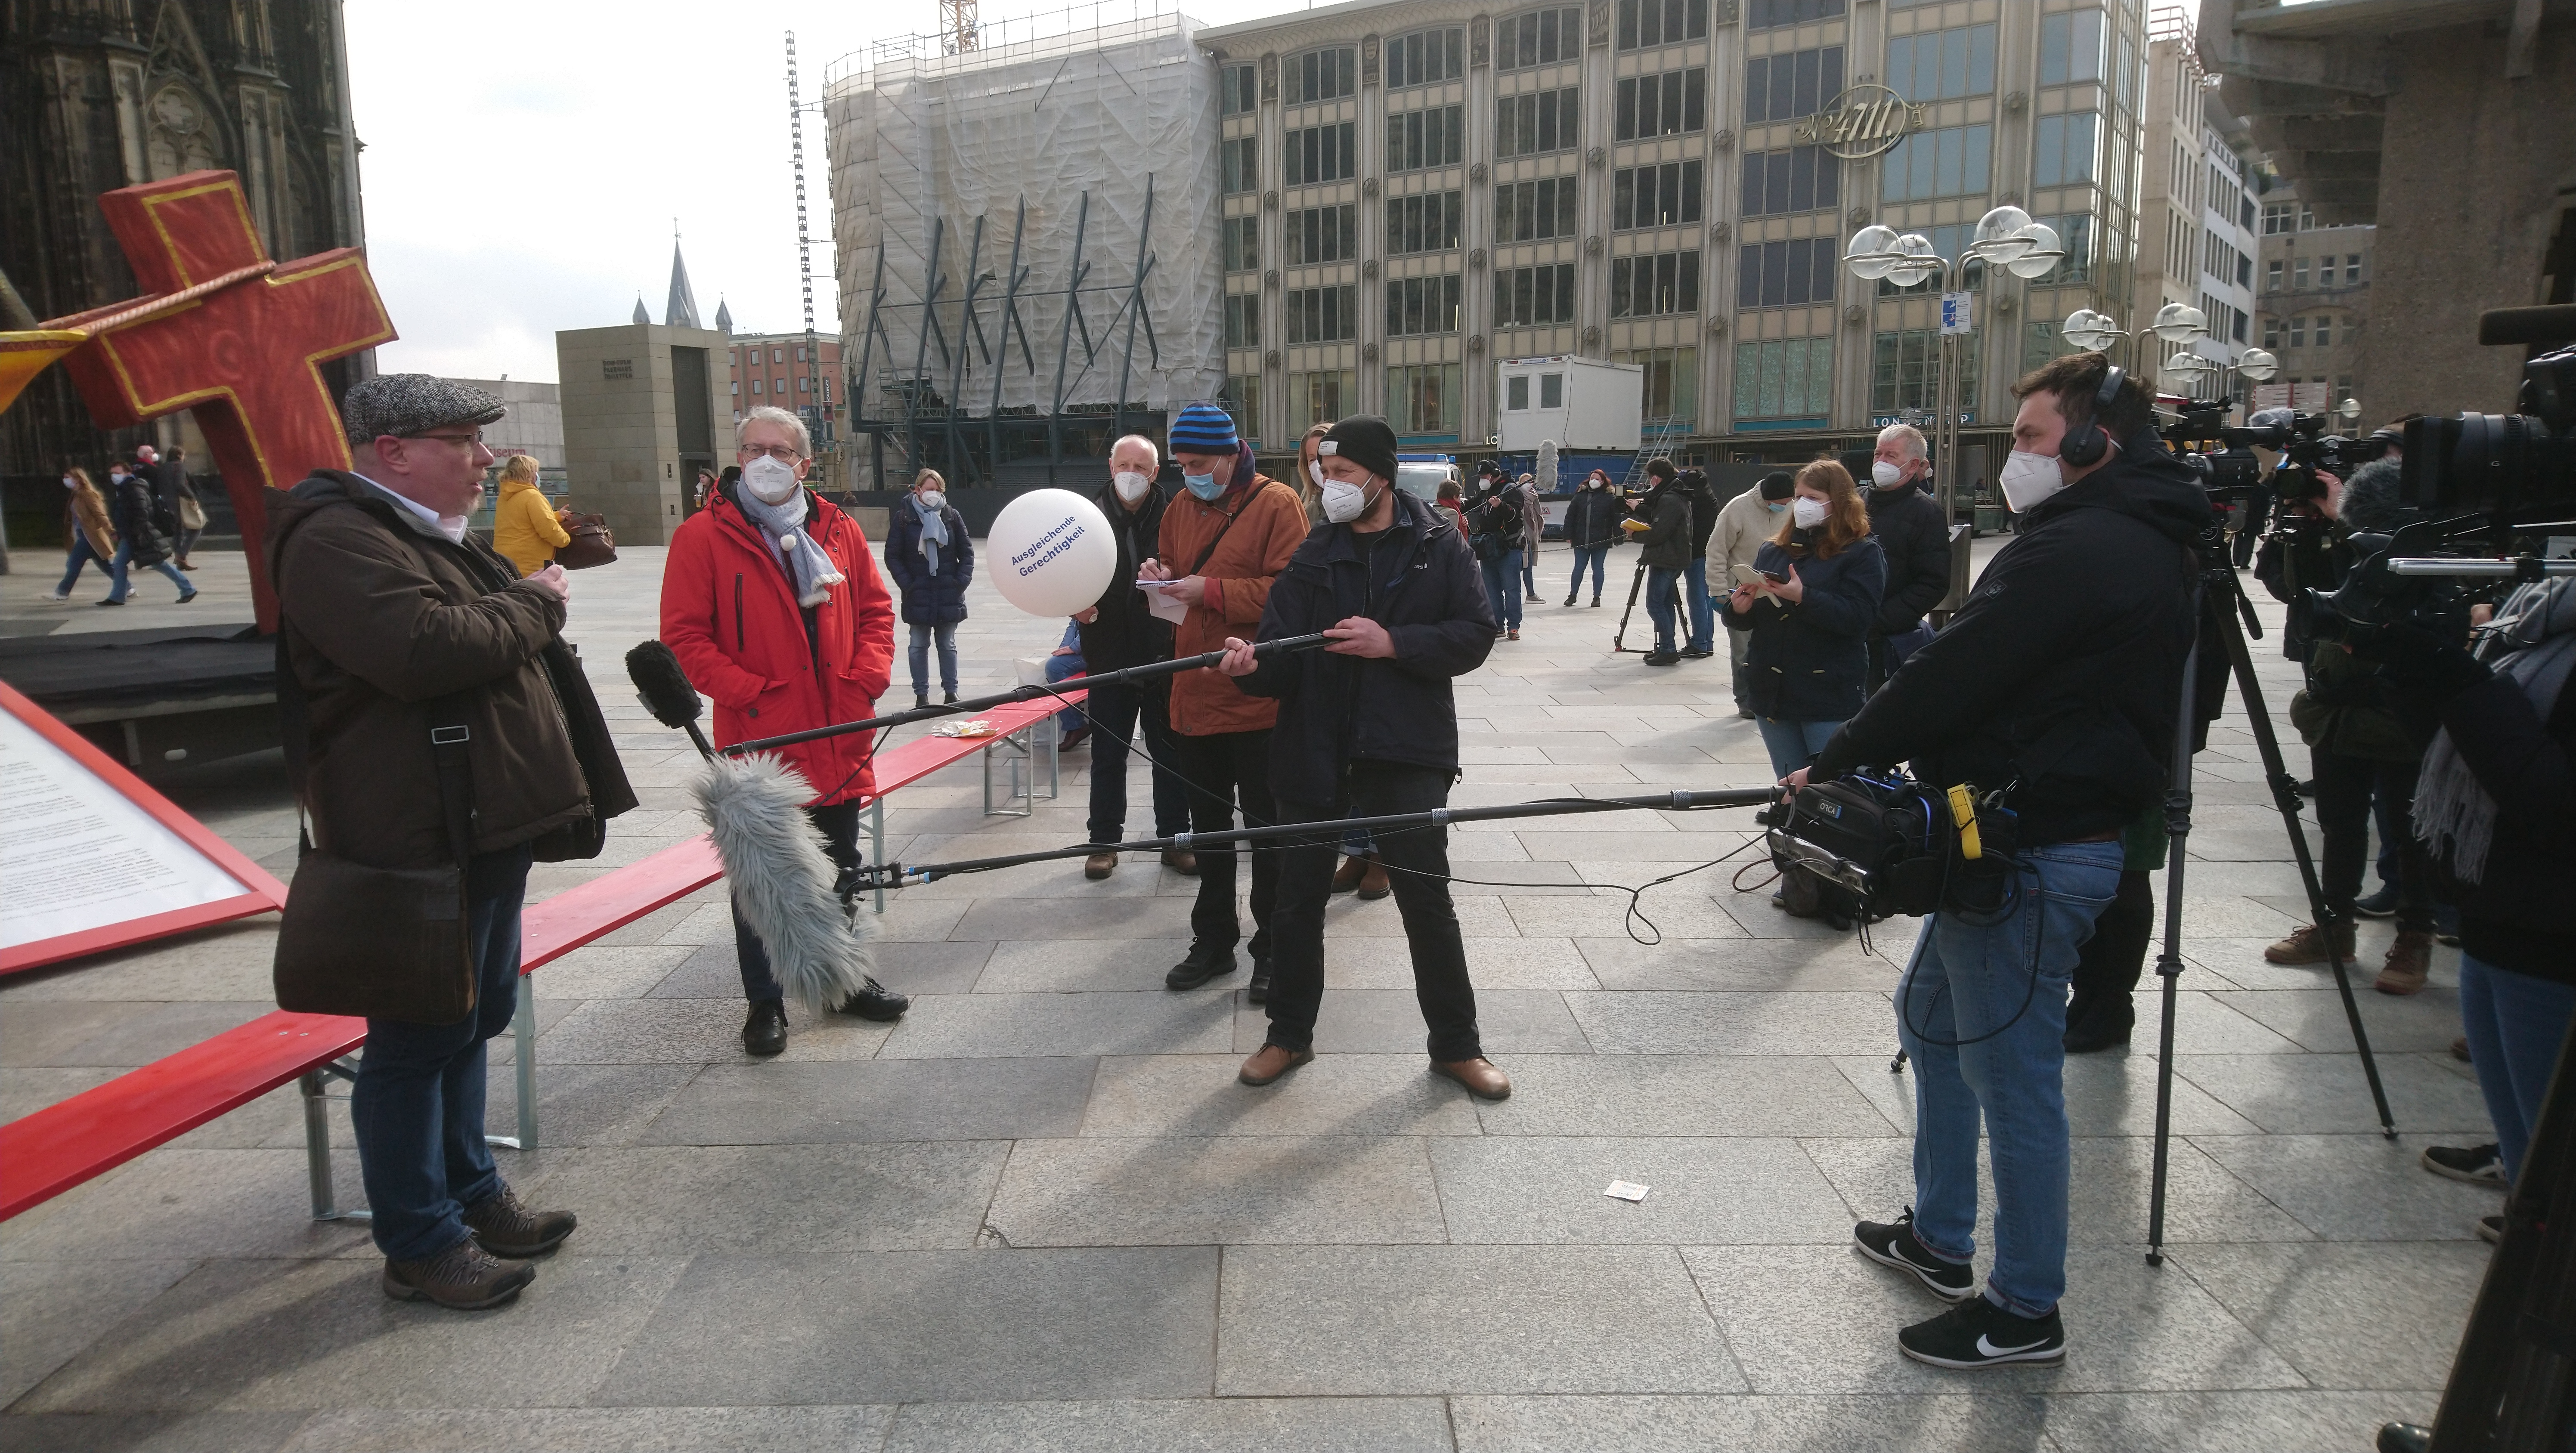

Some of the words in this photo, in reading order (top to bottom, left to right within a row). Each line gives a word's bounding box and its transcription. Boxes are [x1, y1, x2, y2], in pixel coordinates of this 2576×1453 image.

[950, 45, 954, 54] 2
[486, 445, 526, 457] useum
[1011, 515, 1075, 566] Ausgleichende
[1019, 525, 1085, 577] Gerechtigkeit
[1820, 803, 1835, 815] ORCA
